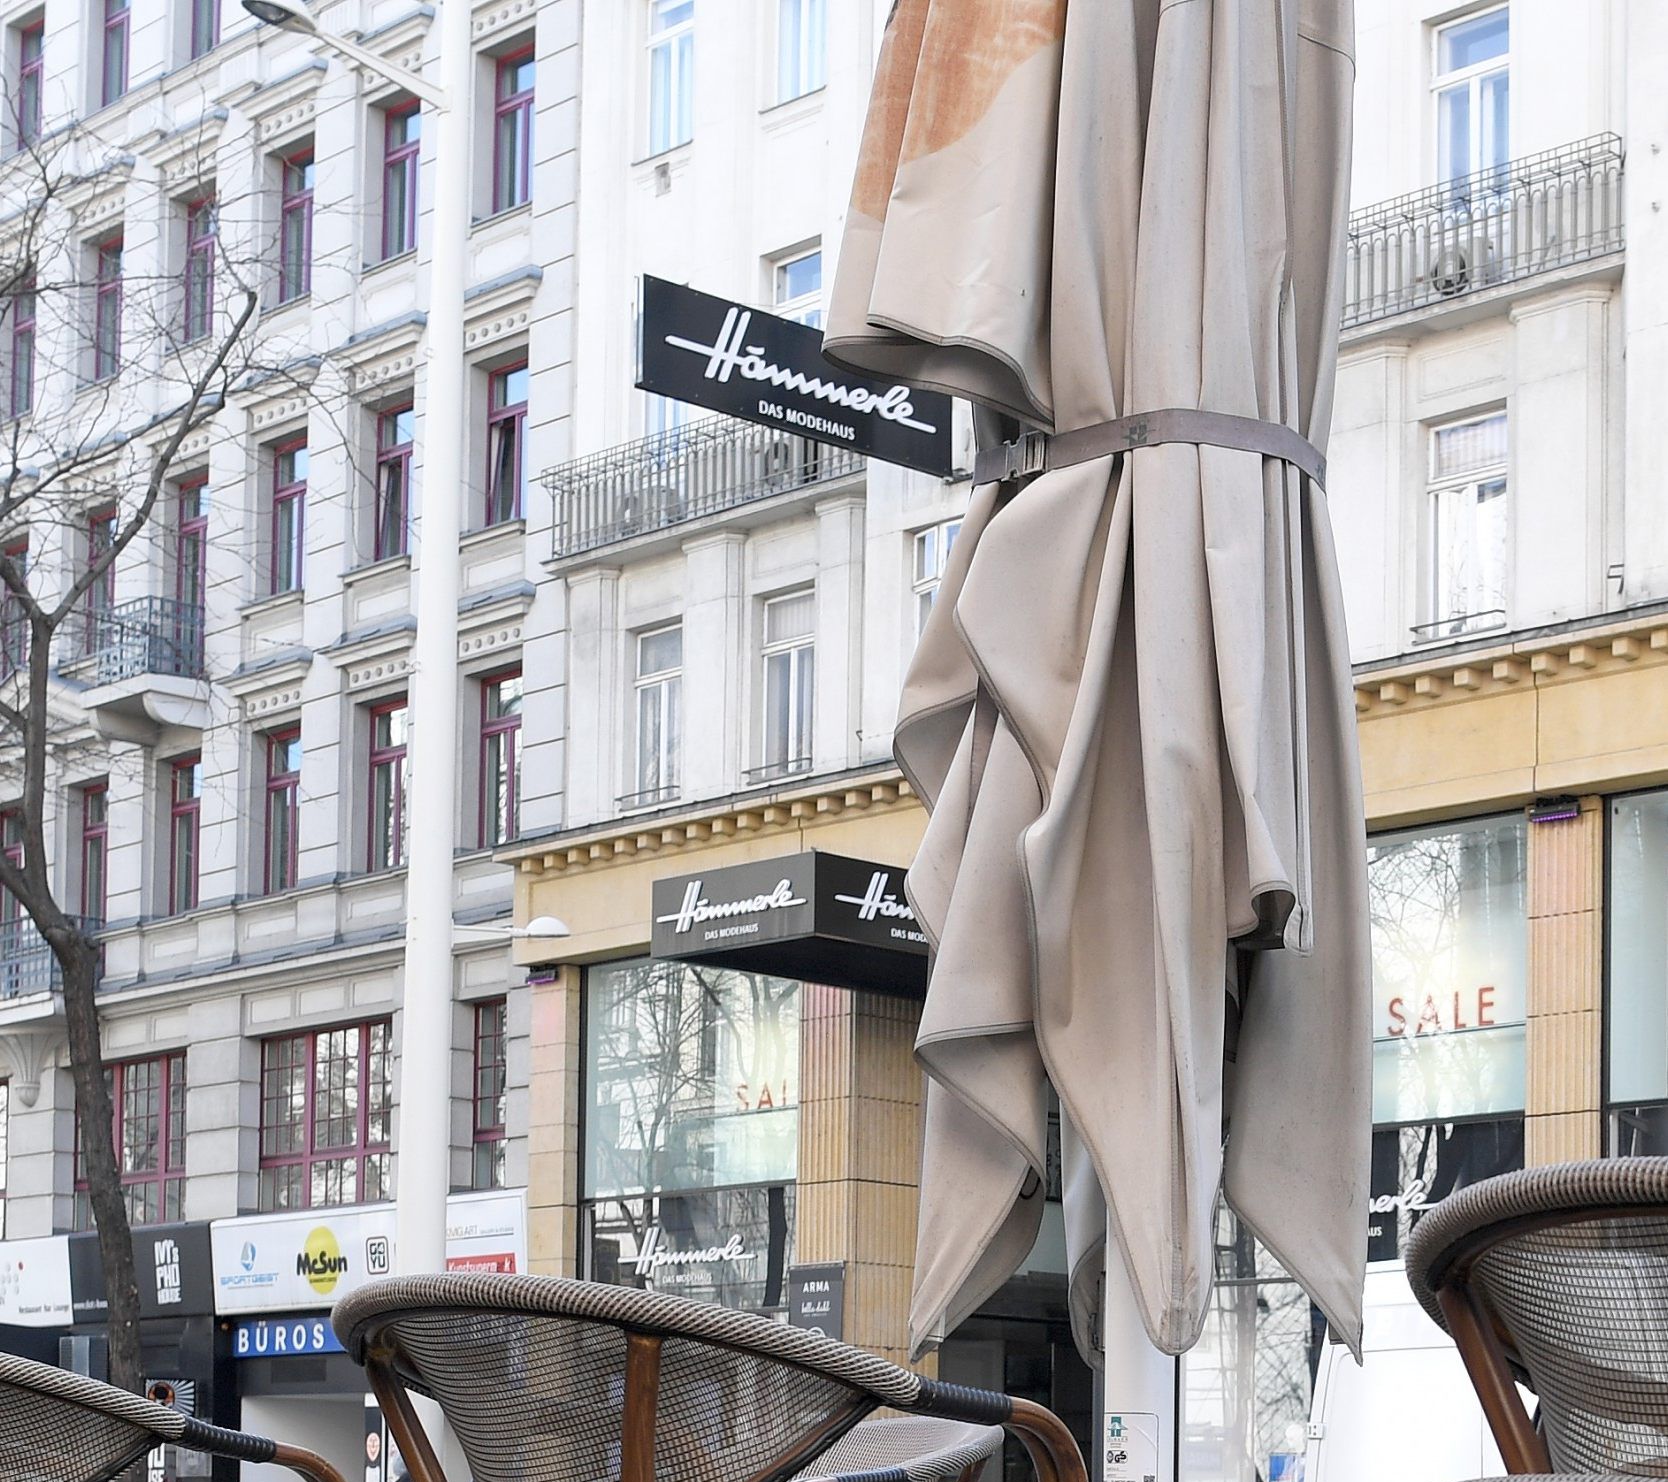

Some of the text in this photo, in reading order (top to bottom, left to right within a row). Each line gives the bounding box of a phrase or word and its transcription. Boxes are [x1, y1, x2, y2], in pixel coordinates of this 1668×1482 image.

[664, 307, 937, 434] Hämmerle
[758, 400, 856, 441] DAS MODEHAUS
[656, 878, 807, 934] Hämmerle
[704, 922, 759, 941] DAS MODEHAUS
[890, 928, 906, 939] DAS
[1387, 986, 1495, 1037] SALE
[296, 1251, 348, 1276] McSun
[370, 1256, 385, 1269] YU
[618, 1227, 758, 1276] Hämmerle
[156, 1263, 180, 1290] PHO
[802, 1281, 830, 1293] ARMA
[238, 1321, 325, 1353] BÜROS
